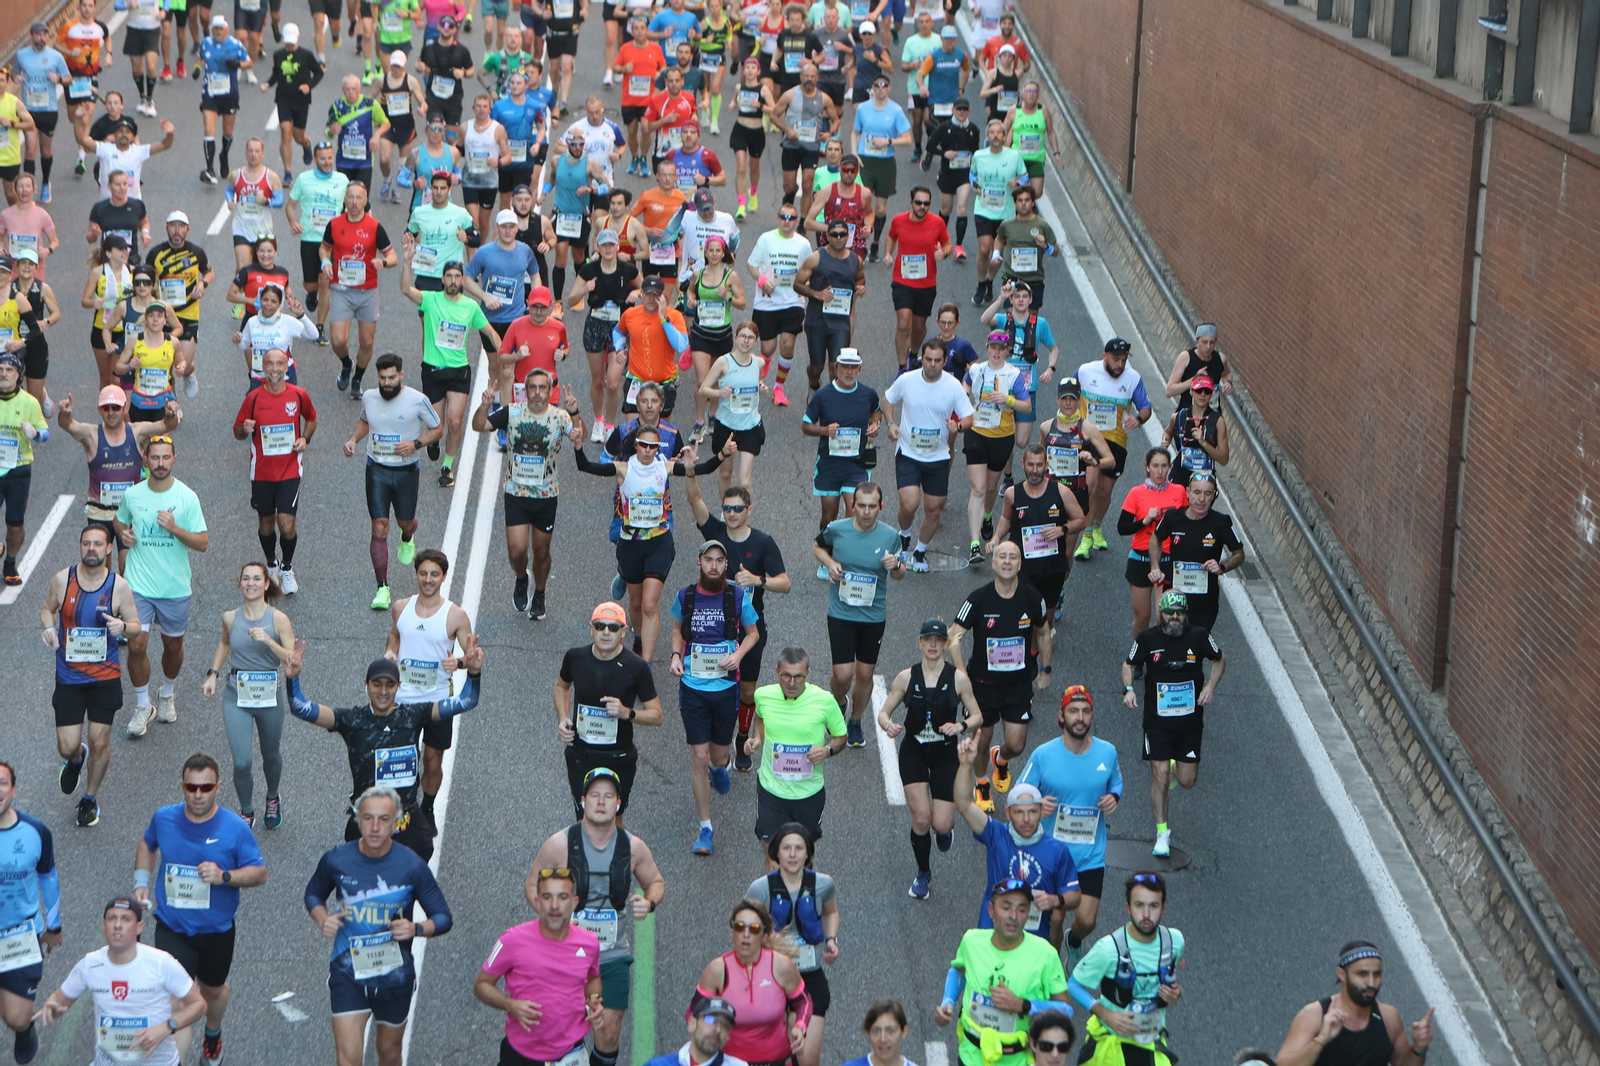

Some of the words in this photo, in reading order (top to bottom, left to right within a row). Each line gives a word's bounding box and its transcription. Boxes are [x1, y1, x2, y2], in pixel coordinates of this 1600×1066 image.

[272, 426, 291, 434] ZURICH
[853, 575, 873, 583] ZURICH
[80, 629, 103, 637] ZURICH
[999, 640, 1019, 648] ZURICH
[704, 646, 725, 654] ZURICH
[413, 660, 435, 670] ZURICH
[250, 673, 273, 681] ZURICH
[1170, 684, 1190, 692] ZURICH
[786, 745, 810, 753] ZURICH
[391, 751, 413, 762] ZURICH
[1073, 808, 1094, 816] ZURICH
[588, 913, 612, 921] ZURICH
[366, 935, 392, 946] ZURICH
[115, 1017, 144, 1027] ZURICH
